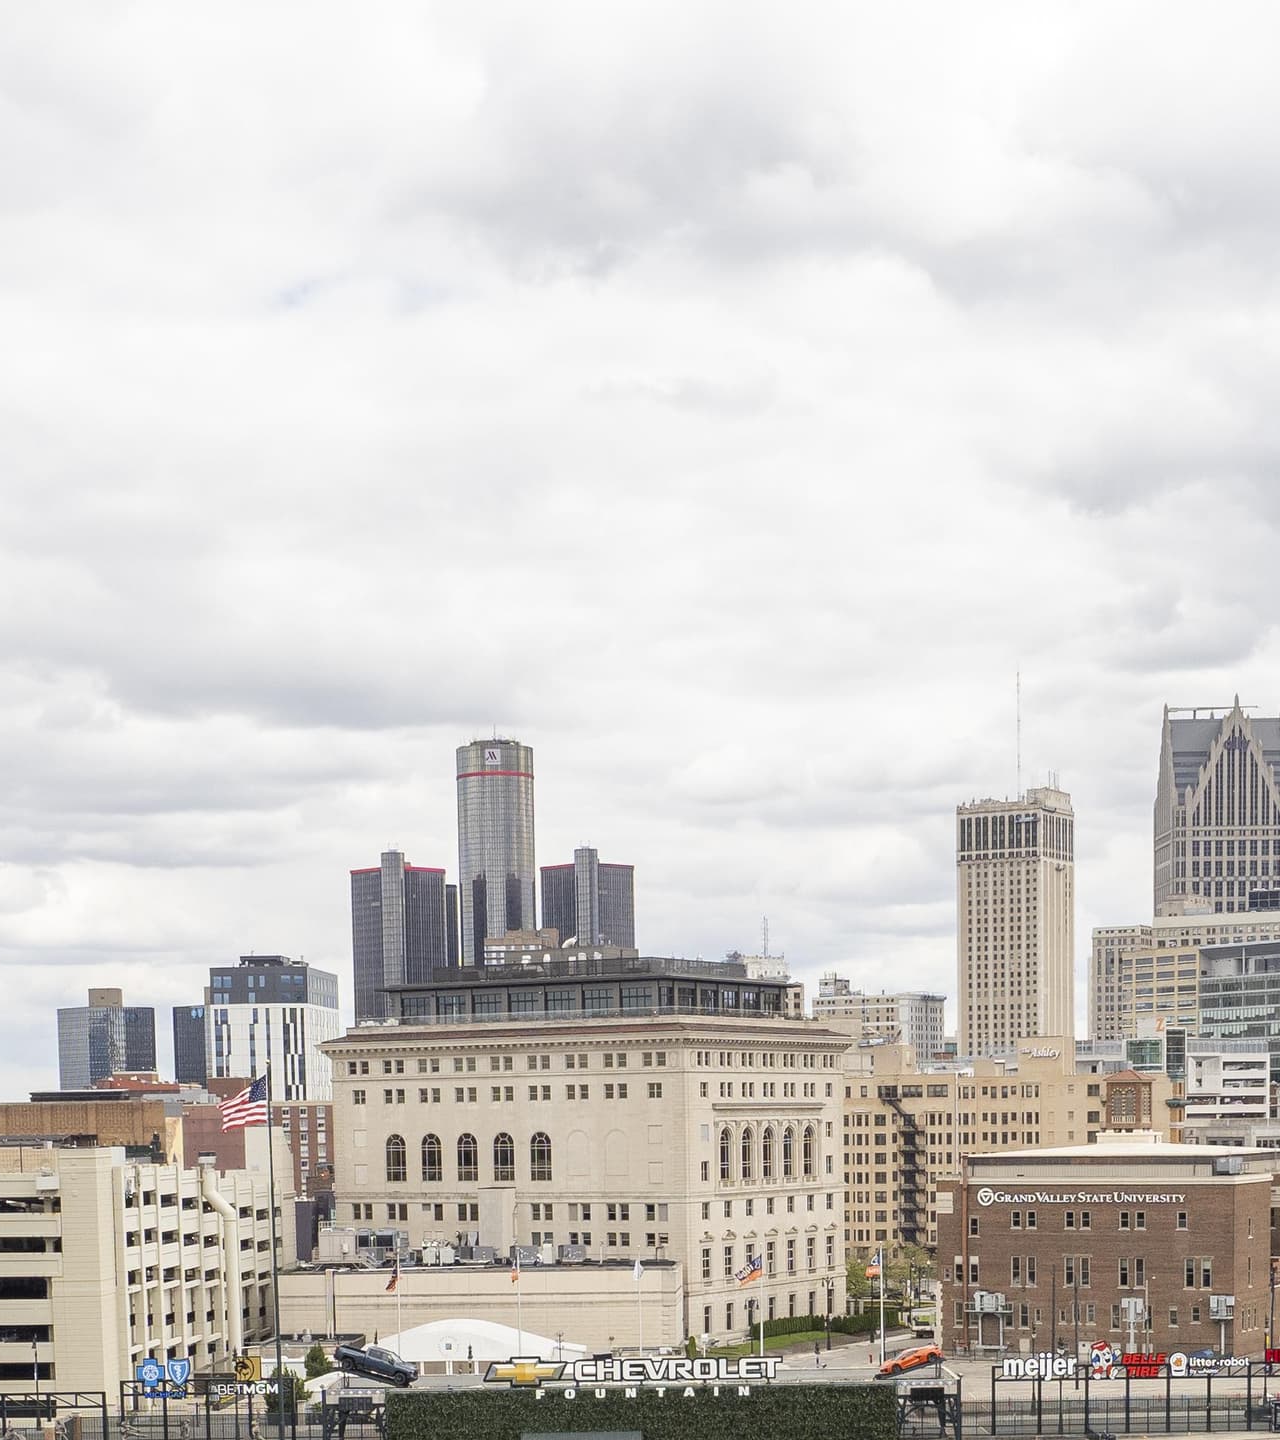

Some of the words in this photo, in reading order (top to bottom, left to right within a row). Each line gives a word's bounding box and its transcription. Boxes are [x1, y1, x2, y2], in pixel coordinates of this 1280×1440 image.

[1029, 1046, 1061, 1060] Ashley
[1122, 1352, 1166, 1365] BELLE
[574, 1356, 783, 1381] CHEVROLET
[1003, 1352, 1077, 1381] meijer
[1126, 1366, 1160, 1377] TIRE
[218, 1383, 279, 1395] BETMGM
[535, 1386, 750, 1399] FOUNTAIN
